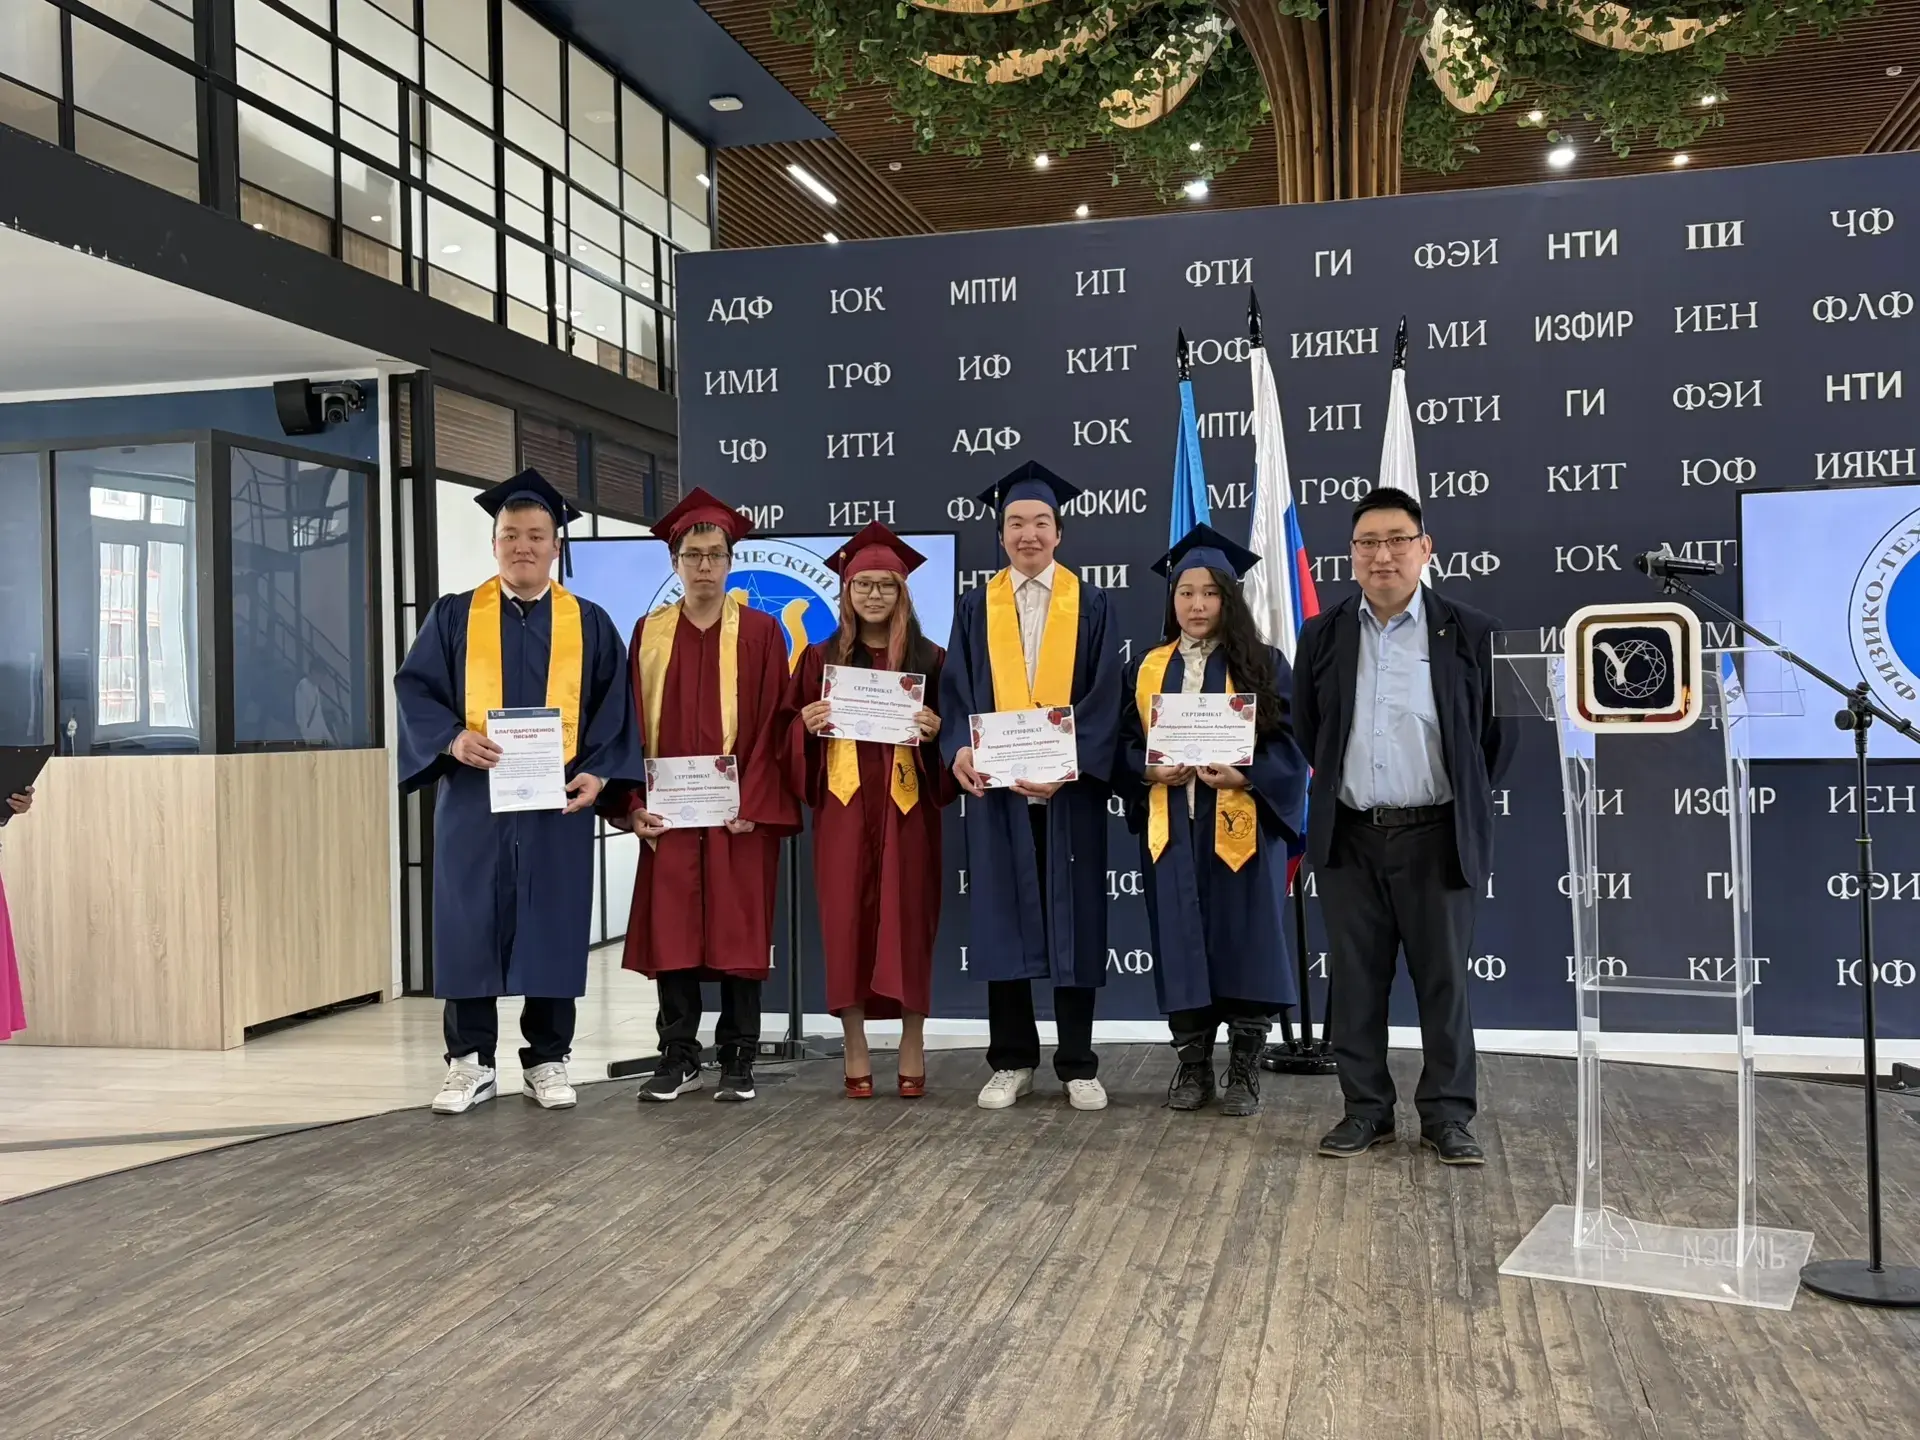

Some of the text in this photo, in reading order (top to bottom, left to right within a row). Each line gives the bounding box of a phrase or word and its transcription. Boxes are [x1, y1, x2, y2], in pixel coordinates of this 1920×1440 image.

[1686, 221, 1744, 250] ПИ
[1830, 208, 1894, 236] ЧФ
[1415, 239, 1498, 268] ФЭИ
[1549, 229, 1617, 259] НТИ
[1186, 258, 1253, 287] ФТИ
[1316, 249, 1351, 277] ГИ
[951, 277, 1016, 305] МПТИ
[1076, 268, 1125, 296] ИП
[708, 296, 772, 325] АДФ
[831, 287, 885, 313] ЮК
[1813, 291, 1913, 322] ФЛФ
[1536, 311, 1633, 342] ИЗФИР
[1675, 302, 1758, 333] ИЕН
[1291, 328, 1378, 358] ИЯКН
[1428, 320, 1487, 349] МИ
[1067, 345, 1136, 374] КИТ
[1188, 337, 1251, 367] ЮФ
[828, 362, 890, 388] ГРФ
[959, 354, 1010, 380] ИФ
[705, 368, 778, 395] ИМИ
[1673, 380, 1762, 410] ФЭИ
[1827, 371, 1901, 402] НТИ
[1415, 395, 1501, 425] ФТИ
[1567, 389, 1604, 416] ГИ
[1073, 418, 1132, 445] ЮК
[1309, 404, 1361, 432] ИП
[719, 439, 766, 463] ЧФ
[827, 432, 894, 459] ИТИ
[952, 427, 1020, 455] АДФ
[1547, 463, 1626, 492] КИТ
[1681, 457, 1756, 486] ЮФ
[1815, 448, 1918, 481] ИЯКН
[1300, 477, 1371, 504] ГРФ
[1430, 471, 1489, 498] ИФ
[735, 504, 784, 530] ФИР
[829, 500, 895, 525] ИЕН
[1555, 544, 1621, 572] ЮК
[1661, 539, 1737, 566] МПТ
[734, 550, 833, 592] ЧЕСКИЙ
[1080, 564, 1129, 589] ПИ
[1862, 523, 1920, 701] ФИЗИКО-ТЕХ
[494, 727, 556, 735] БЛАГОДАРСТВЕННОЕ
[1002, 727, 1042, 736] СЕРТИФИКАТ
[1828, 786, 1916, 813] ИЕН
[1837, 959, 1916, 986] ЮФ
